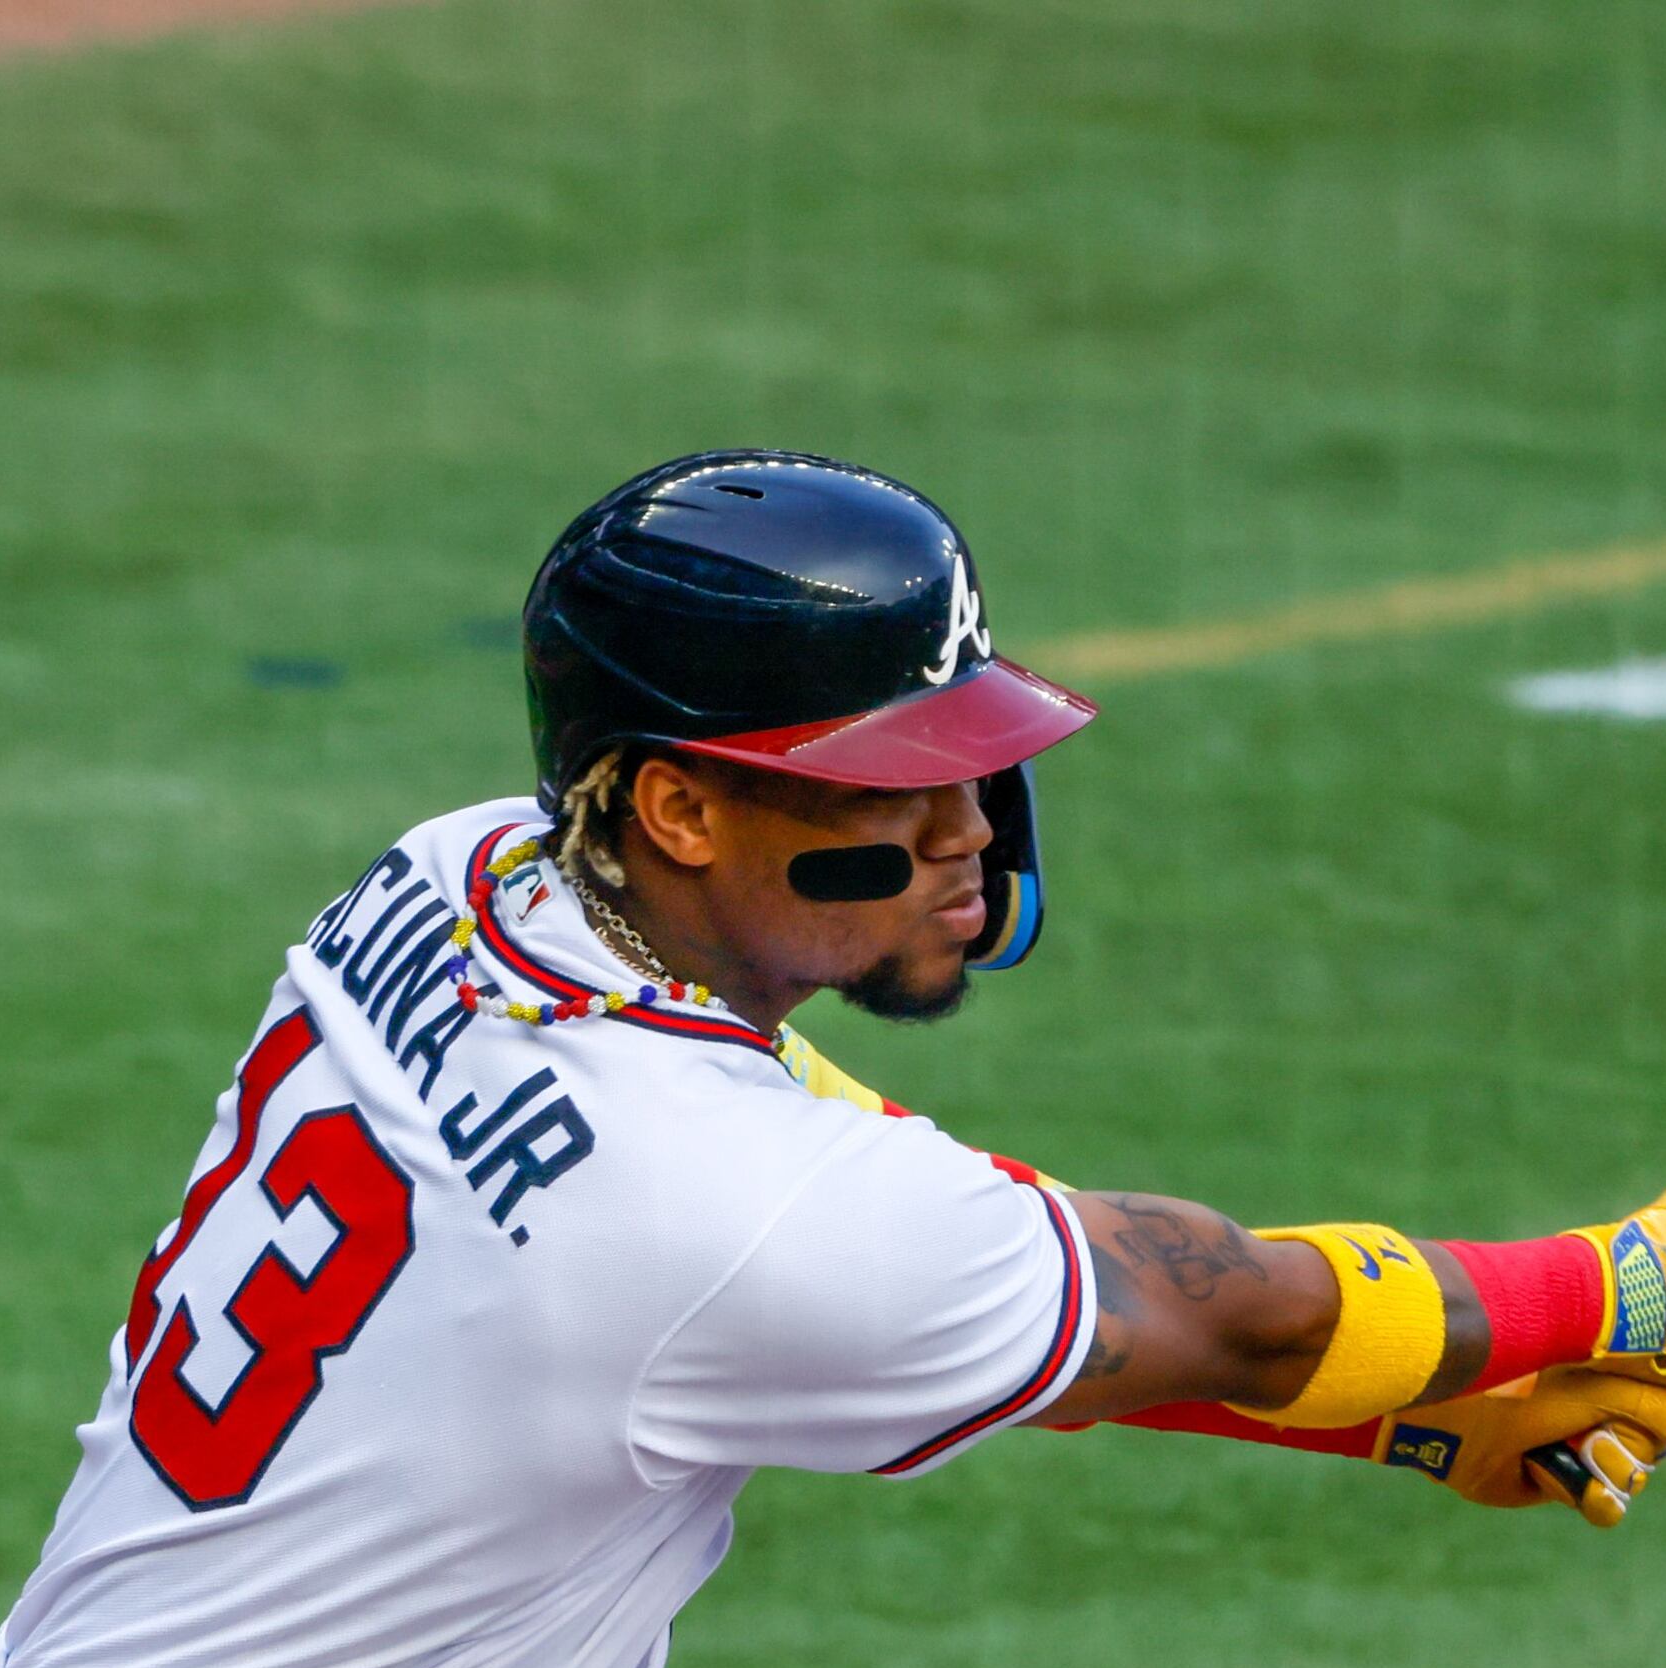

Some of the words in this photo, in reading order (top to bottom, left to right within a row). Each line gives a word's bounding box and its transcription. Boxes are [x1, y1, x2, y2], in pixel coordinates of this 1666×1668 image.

[923, 553, 992, 686] A
[439, 1066, 596, 1249] JR.
[126, 1003, 416, 1513] 13
